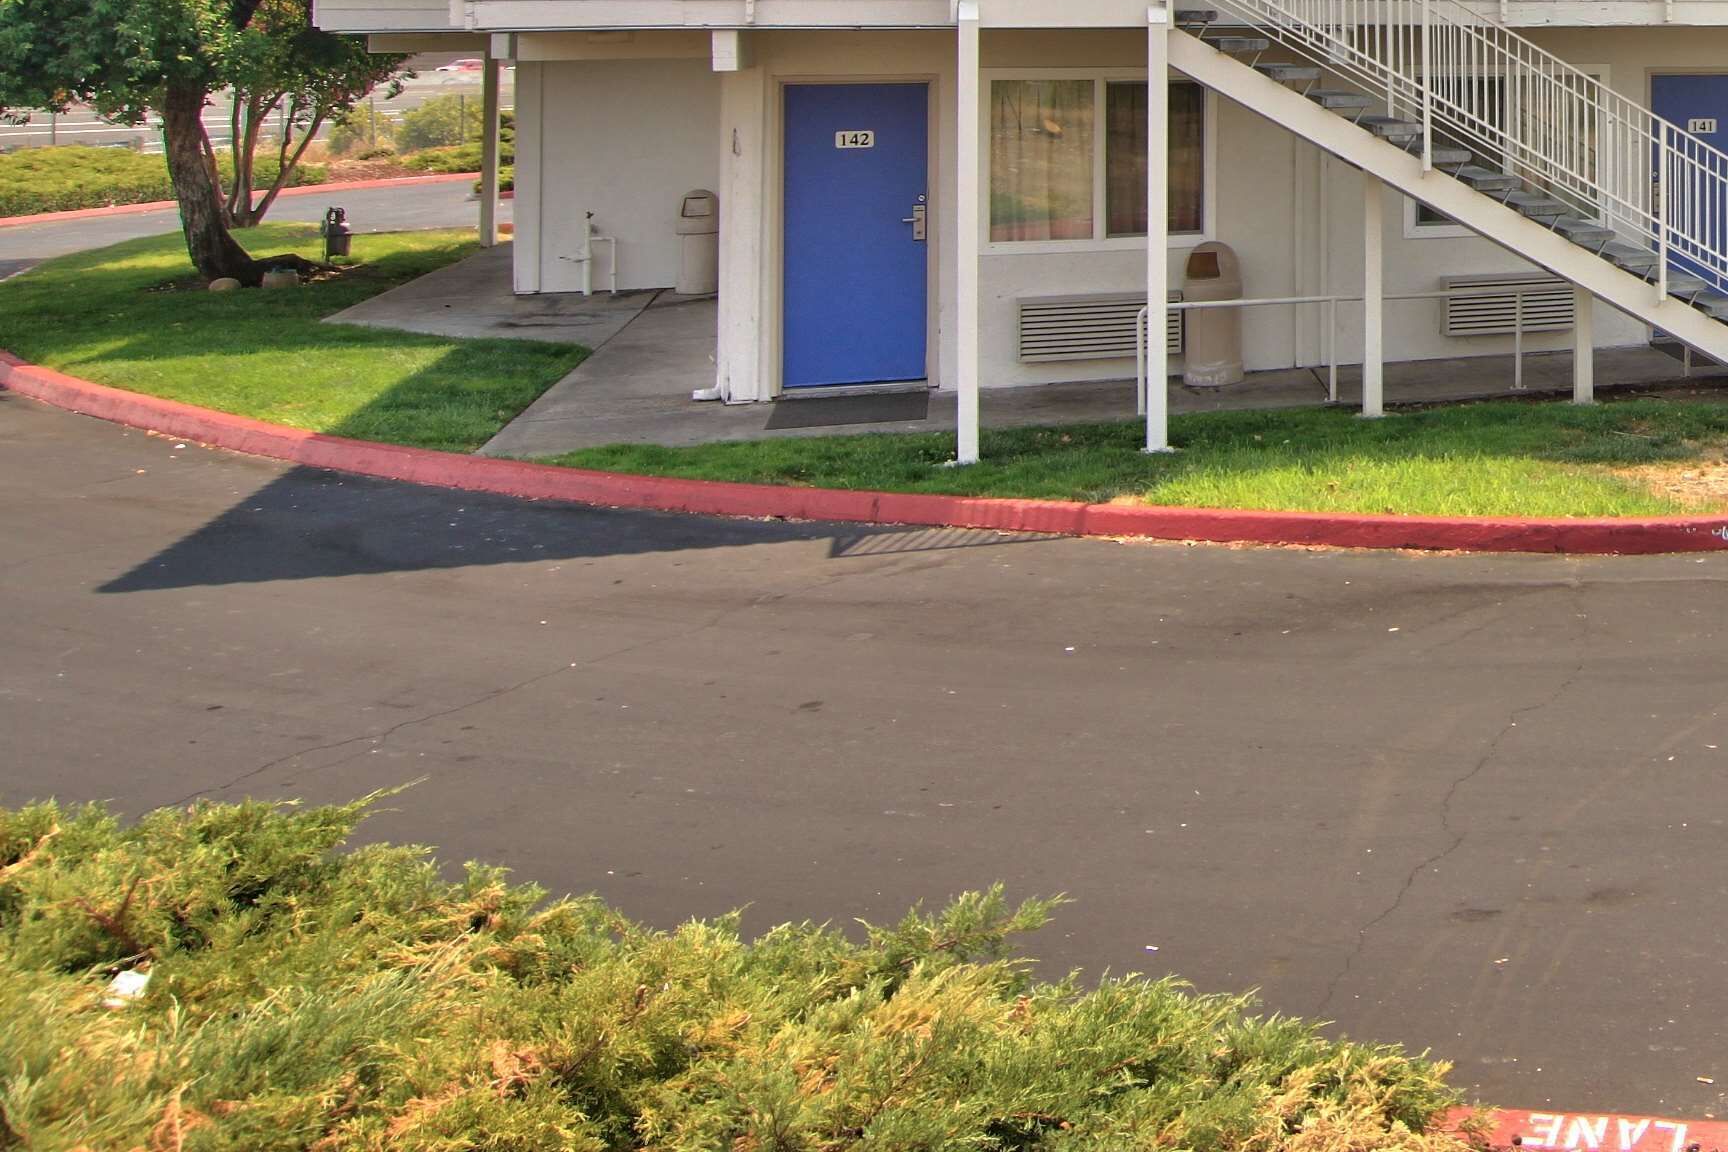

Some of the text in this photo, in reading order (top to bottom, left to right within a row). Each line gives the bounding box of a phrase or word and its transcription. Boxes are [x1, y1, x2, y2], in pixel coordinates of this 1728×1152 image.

[1691, 120, 1714, 132] 141
[840, 133, 869, 146] 142
[1520, 1112, 1688, 1150] LANE
